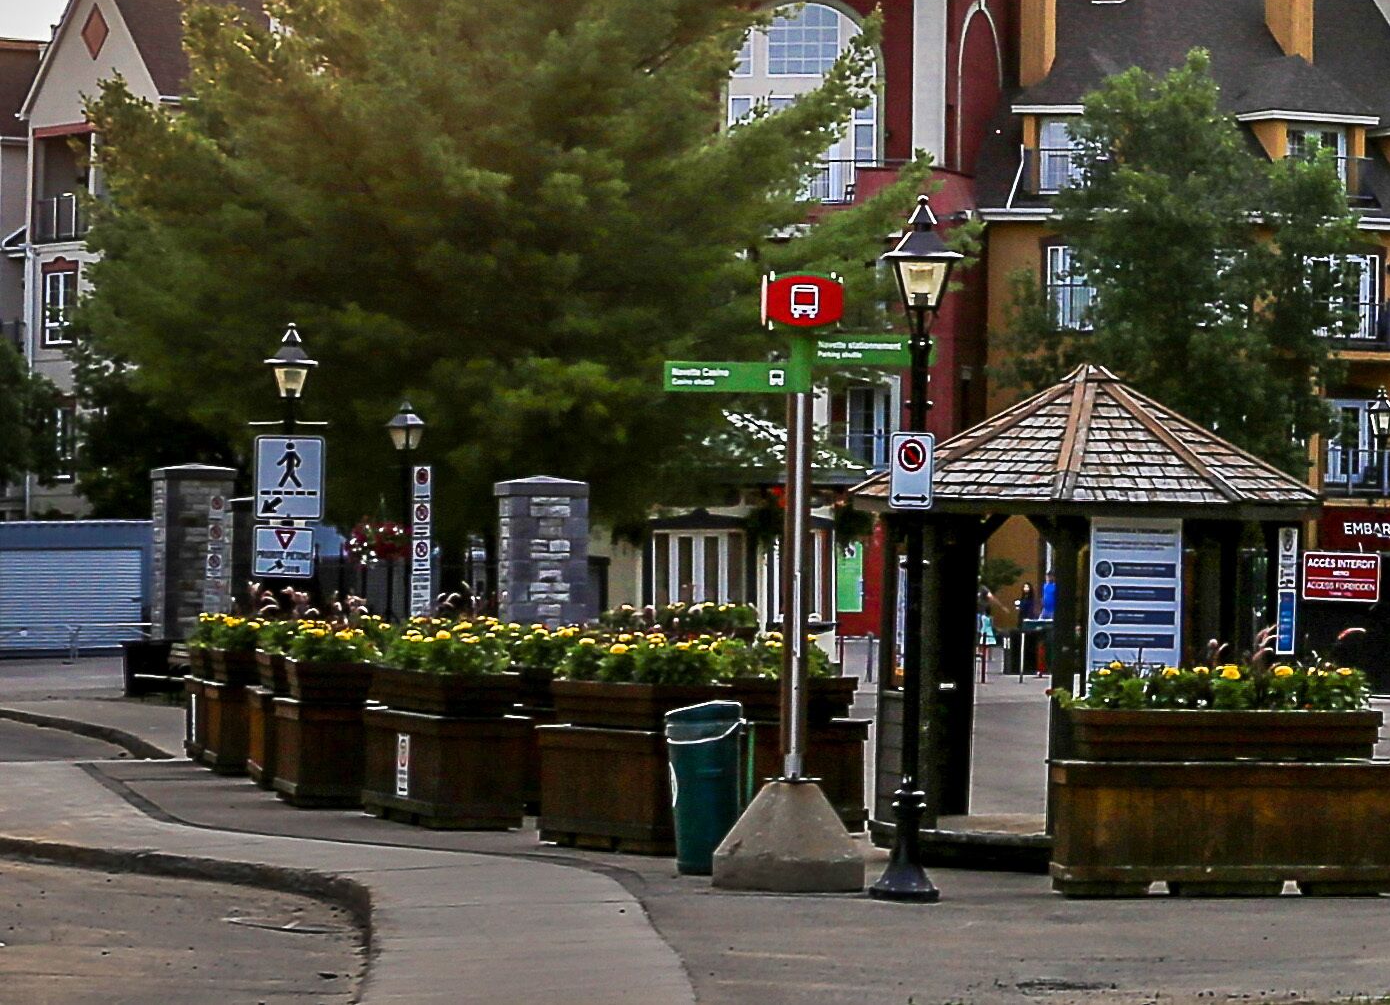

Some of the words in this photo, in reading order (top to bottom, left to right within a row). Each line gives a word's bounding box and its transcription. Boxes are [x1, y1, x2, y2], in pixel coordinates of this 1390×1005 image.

[1338, 559, 1376, 569] INTERDIT
[1307, 581, 1334, 590] ACCESS
[1335, 583, 1376, 591] FORBIDDEN
